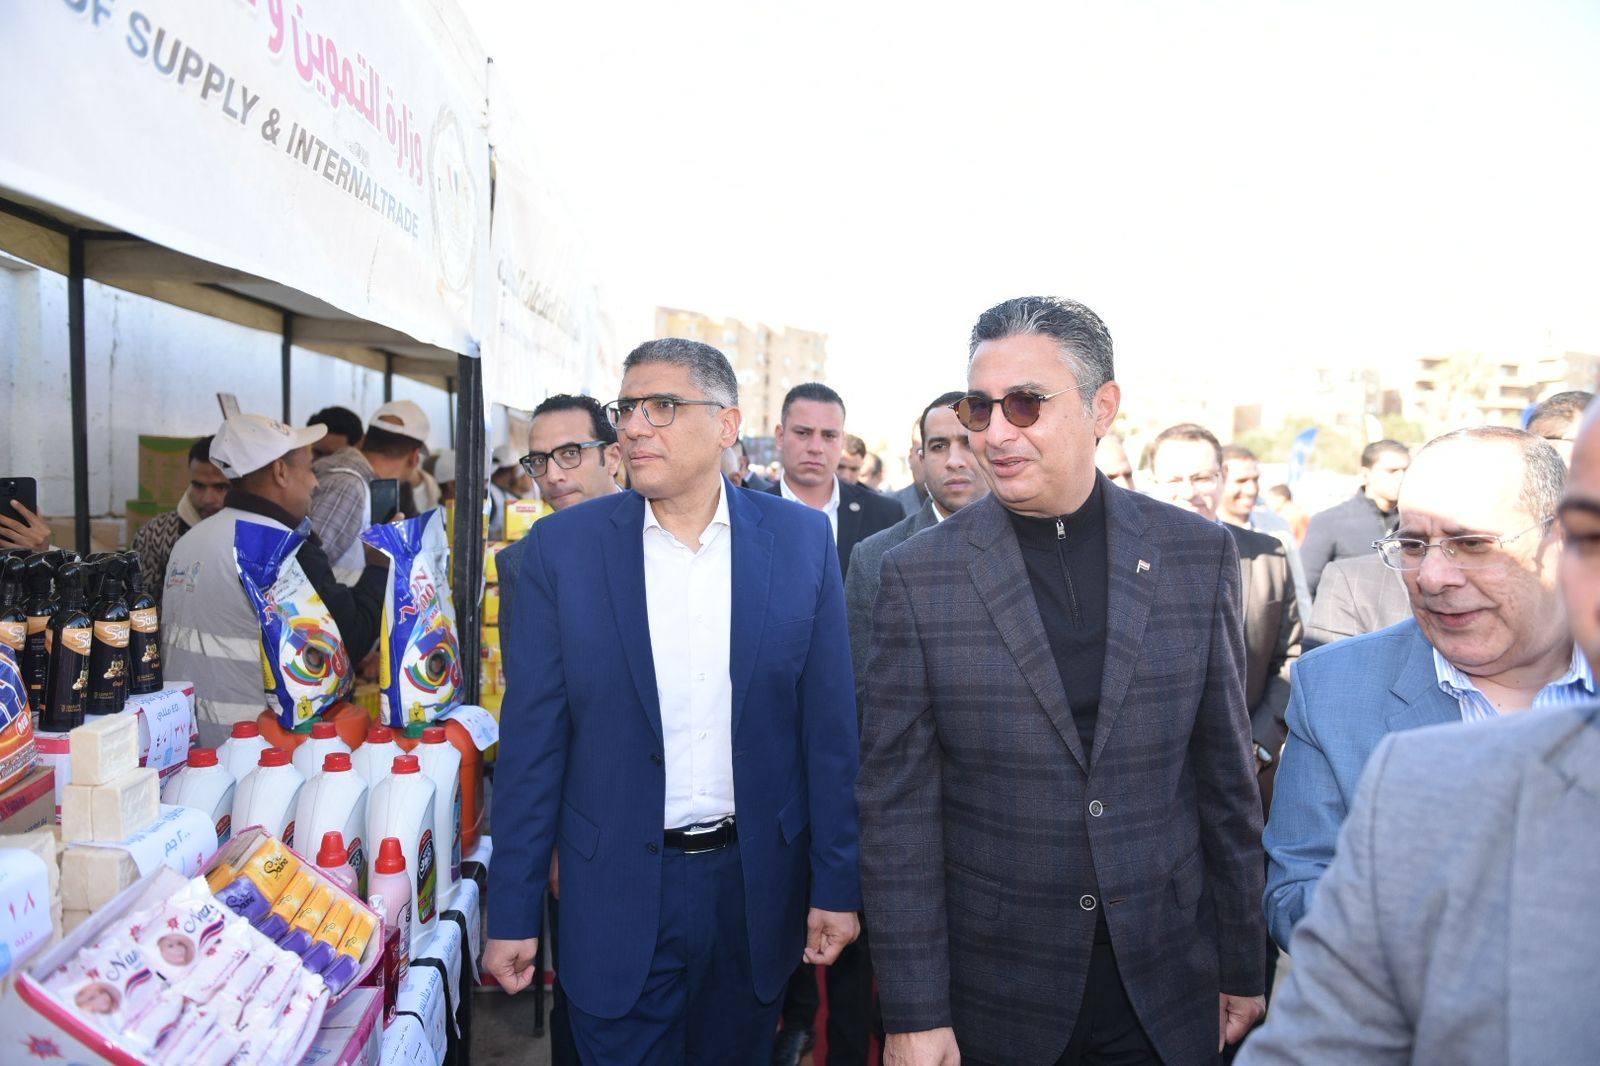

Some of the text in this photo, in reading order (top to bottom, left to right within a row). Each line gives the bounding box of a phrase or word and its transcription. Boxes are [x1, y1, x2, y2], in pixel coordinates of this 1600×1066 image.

[126, 11, 261, 126] SUPPLY
[261, 108, 281, 146] &
[291, 5, 381, 133] التموين
